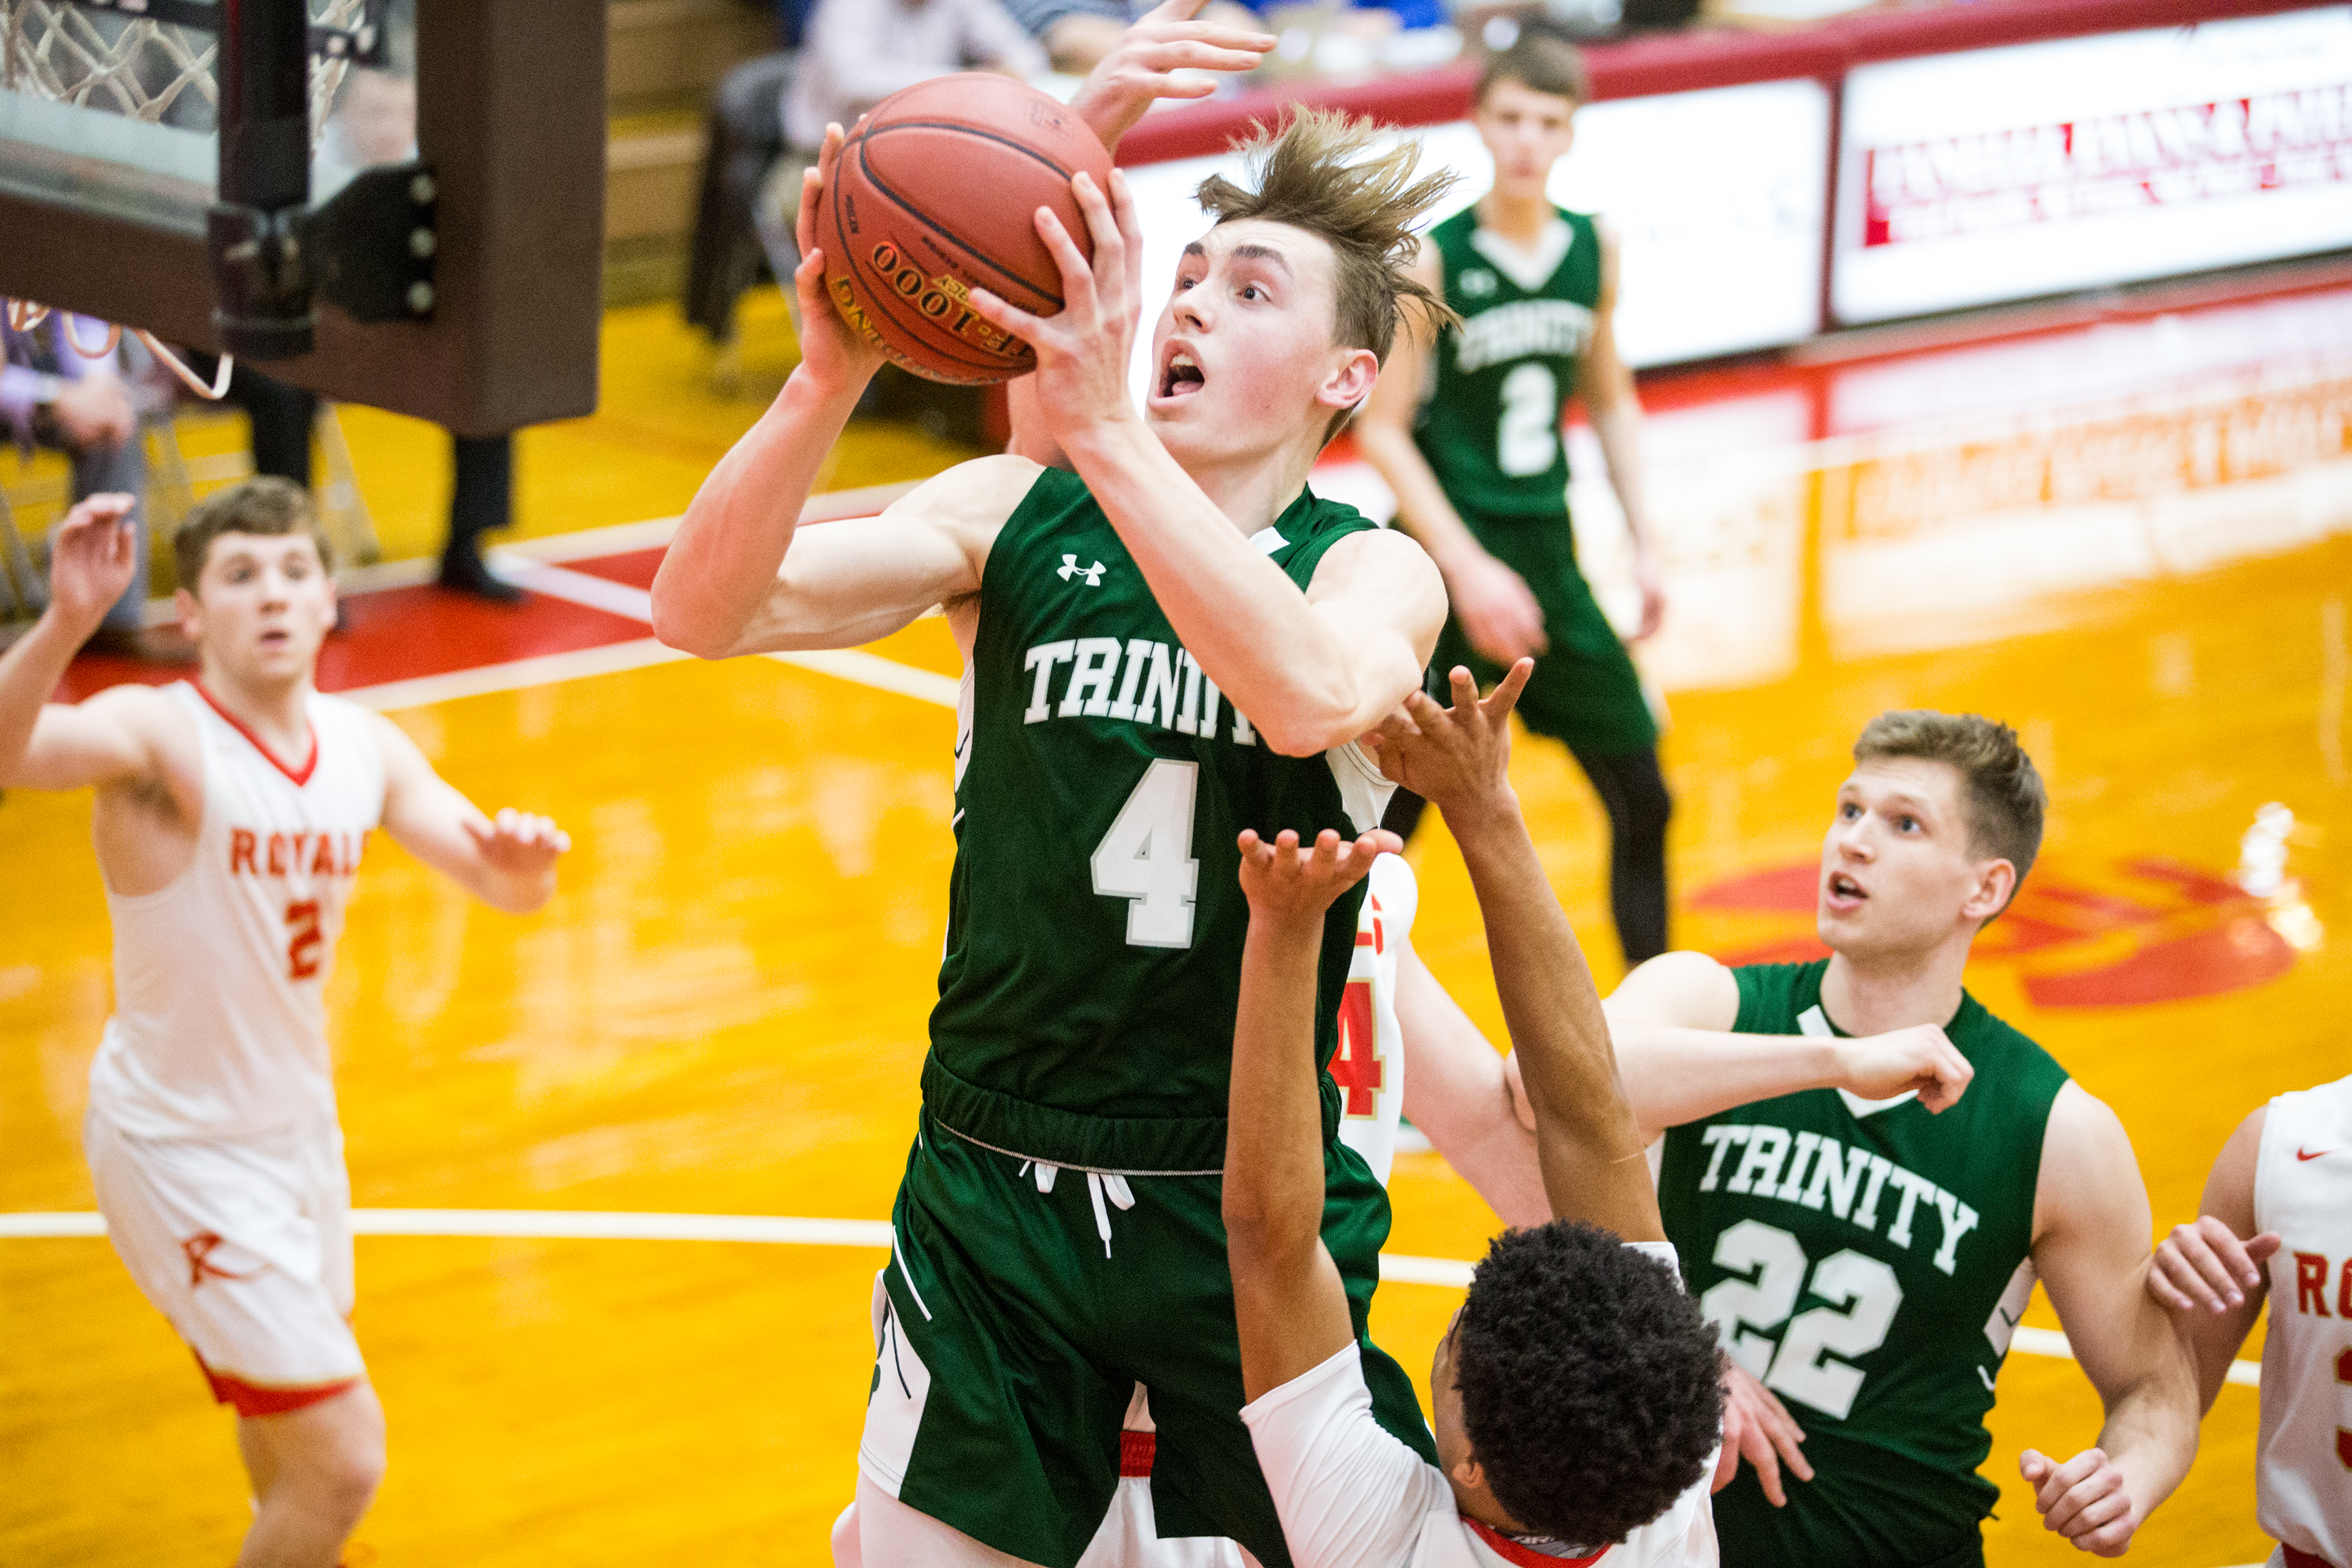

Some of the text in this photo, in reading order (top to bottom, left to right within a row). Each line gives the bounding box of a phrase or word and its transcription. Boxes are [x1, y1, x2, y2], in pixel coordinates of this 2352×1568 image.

[1498, 361, 1557, 477] 2
[1023, 636, 1257, 746] TRINI
[1090, 758, 1200, 949] 4
[285, 899, 323, 981] 2
[1699, 1124, 1979, 1275] TRINITY
[1701, 1219, 1904, 1420] 22
